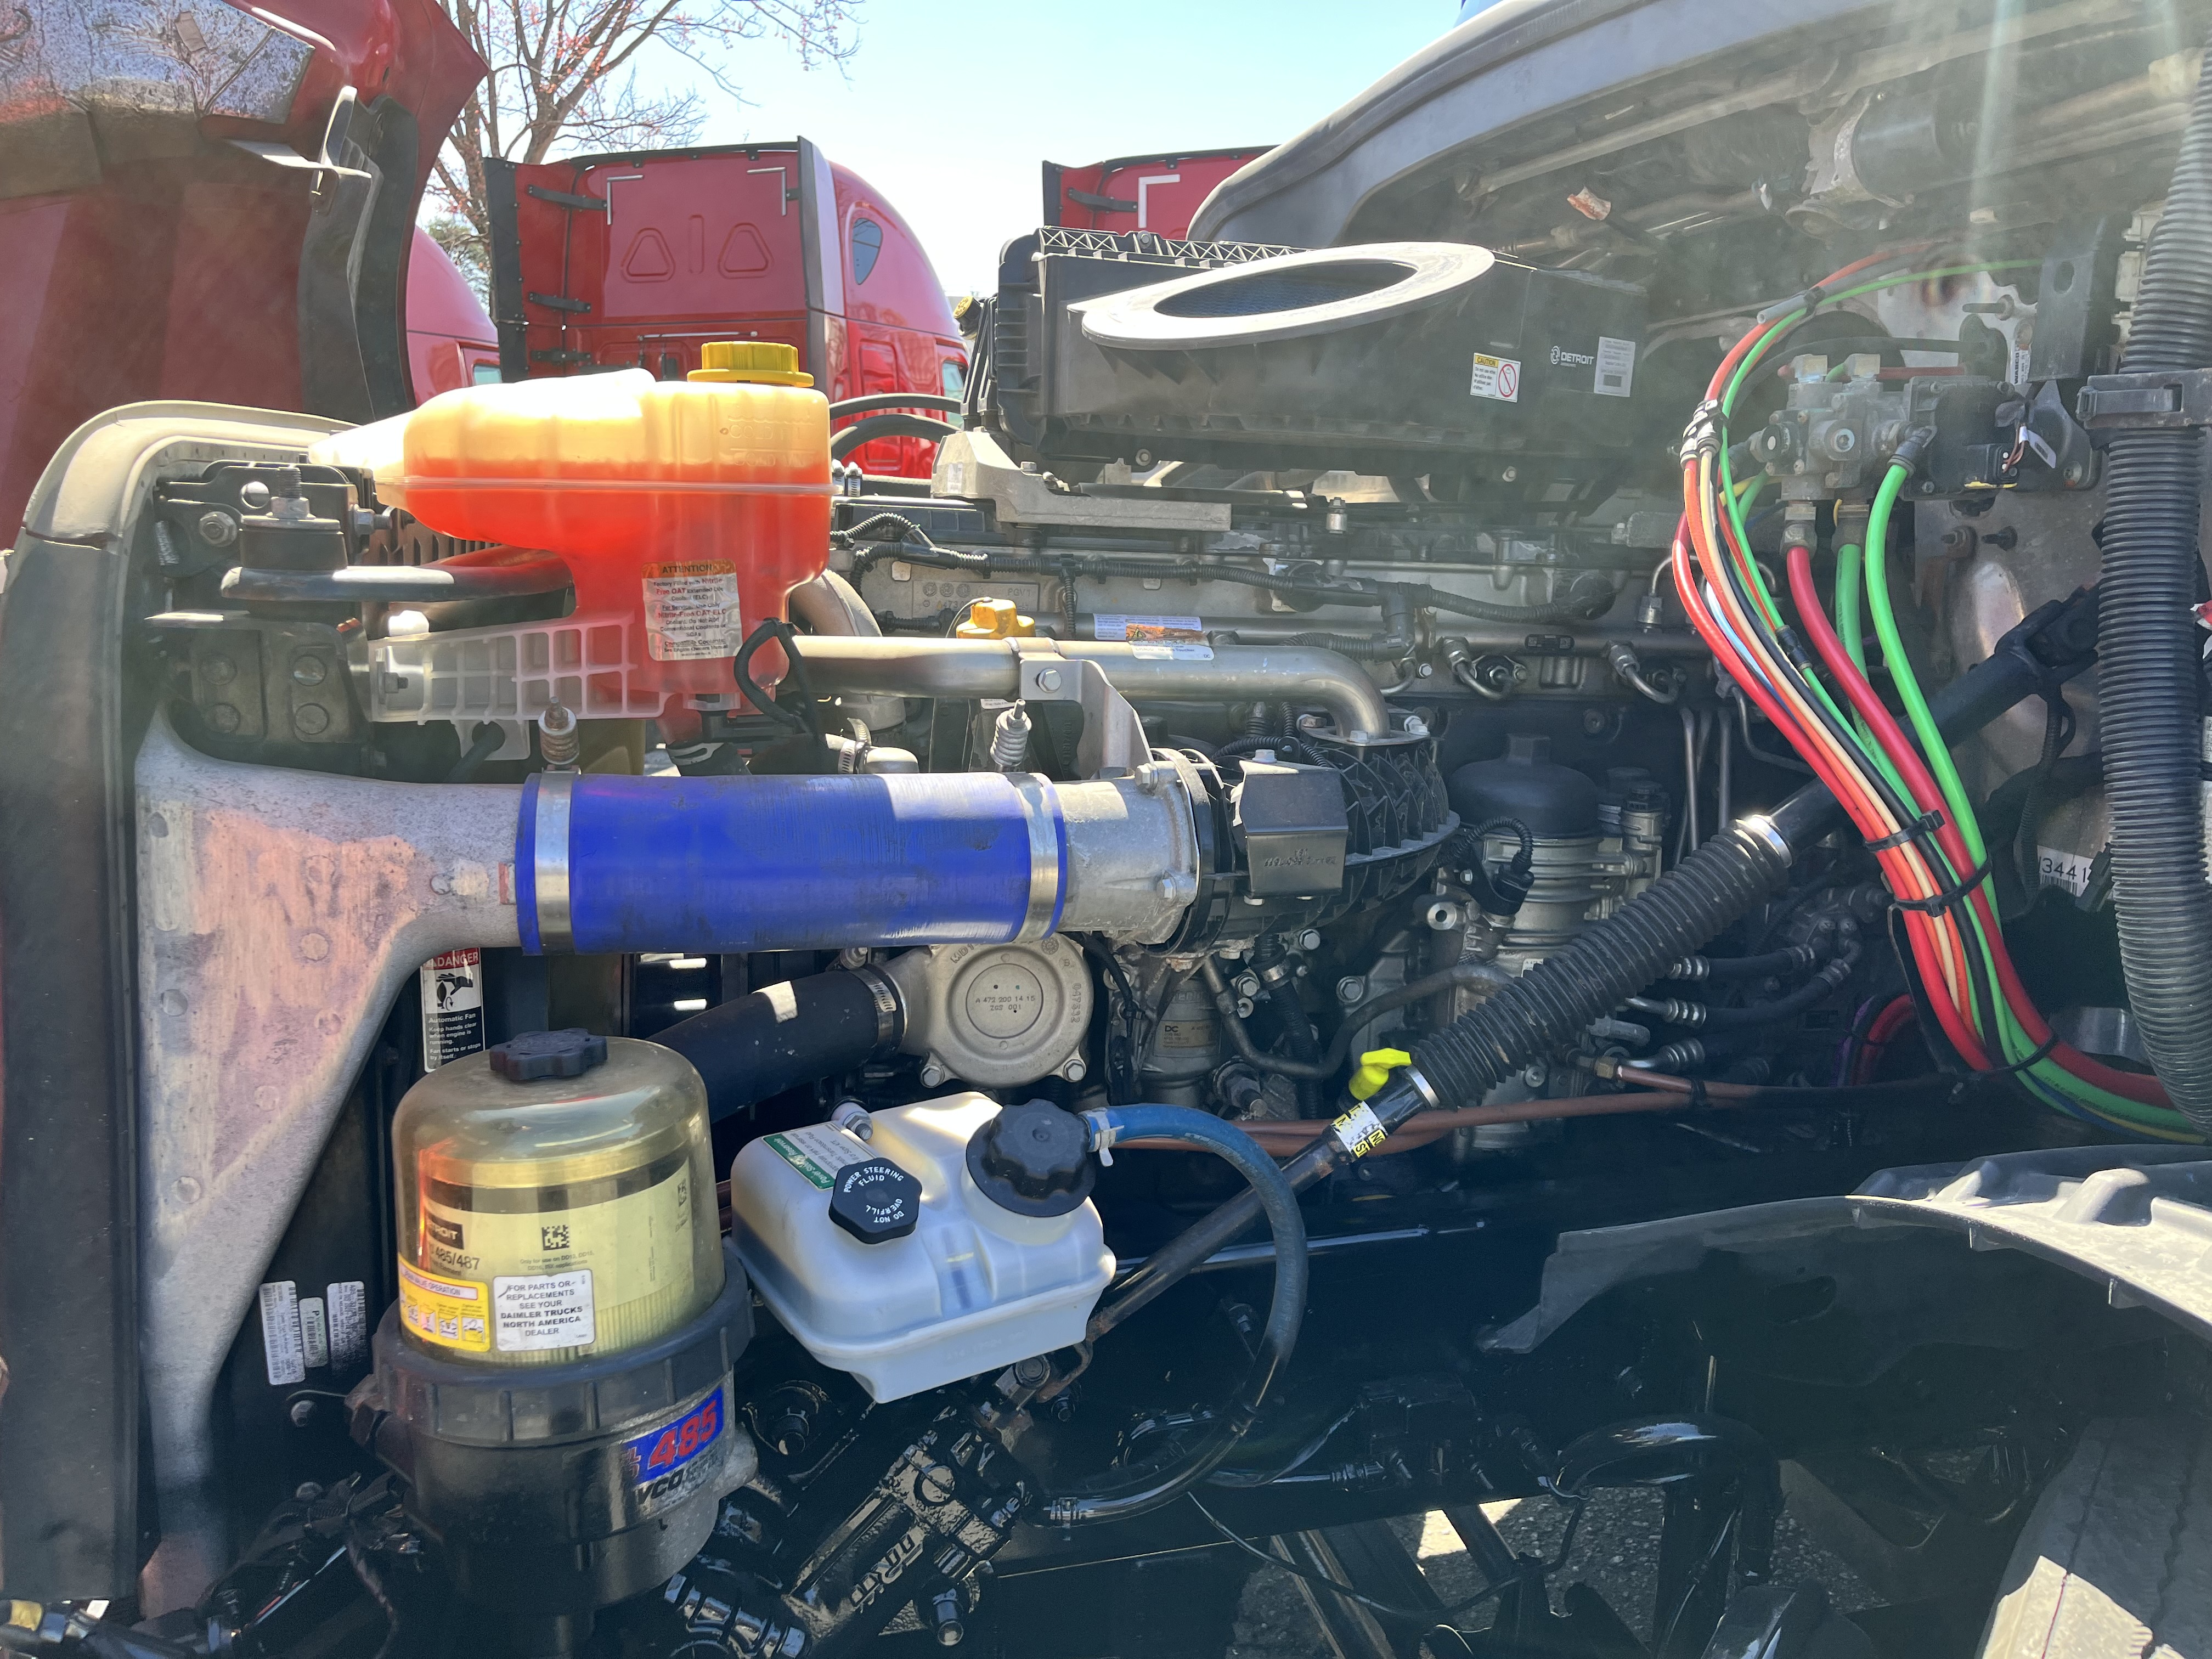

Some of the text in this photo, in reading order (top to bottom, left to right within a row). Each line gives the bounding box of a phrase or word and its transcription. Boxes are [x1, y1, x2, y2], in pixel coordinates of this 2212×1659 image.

[1477, 357, 1496, 366] CAUTION
[1561, 352, 1594, 365] DETROIT
[662, 565, 712, 573] ATTENTION
[438, 952, 478, 967] DANGER
[843, 1166, 904, 1193] POWER STEERING
[858, 1175, 885, 1186] FLUID
[866, 1198, 903, 1215] OVERFILL
[893, 1210, 905, 1220] DO
[528, 1282, 556, 1290] PARTS
[506, 1289, 575, 1300] REPLACEMENTS
[538, 1300, 562, 1308] YOUR
[544, 1306, 583, 1316] TRUCKS
[538, 1316, 581, 1327] AMERICA
[525, 1328, 559, 1336] DEALER
[647, 1400, 717, 1470] 485
